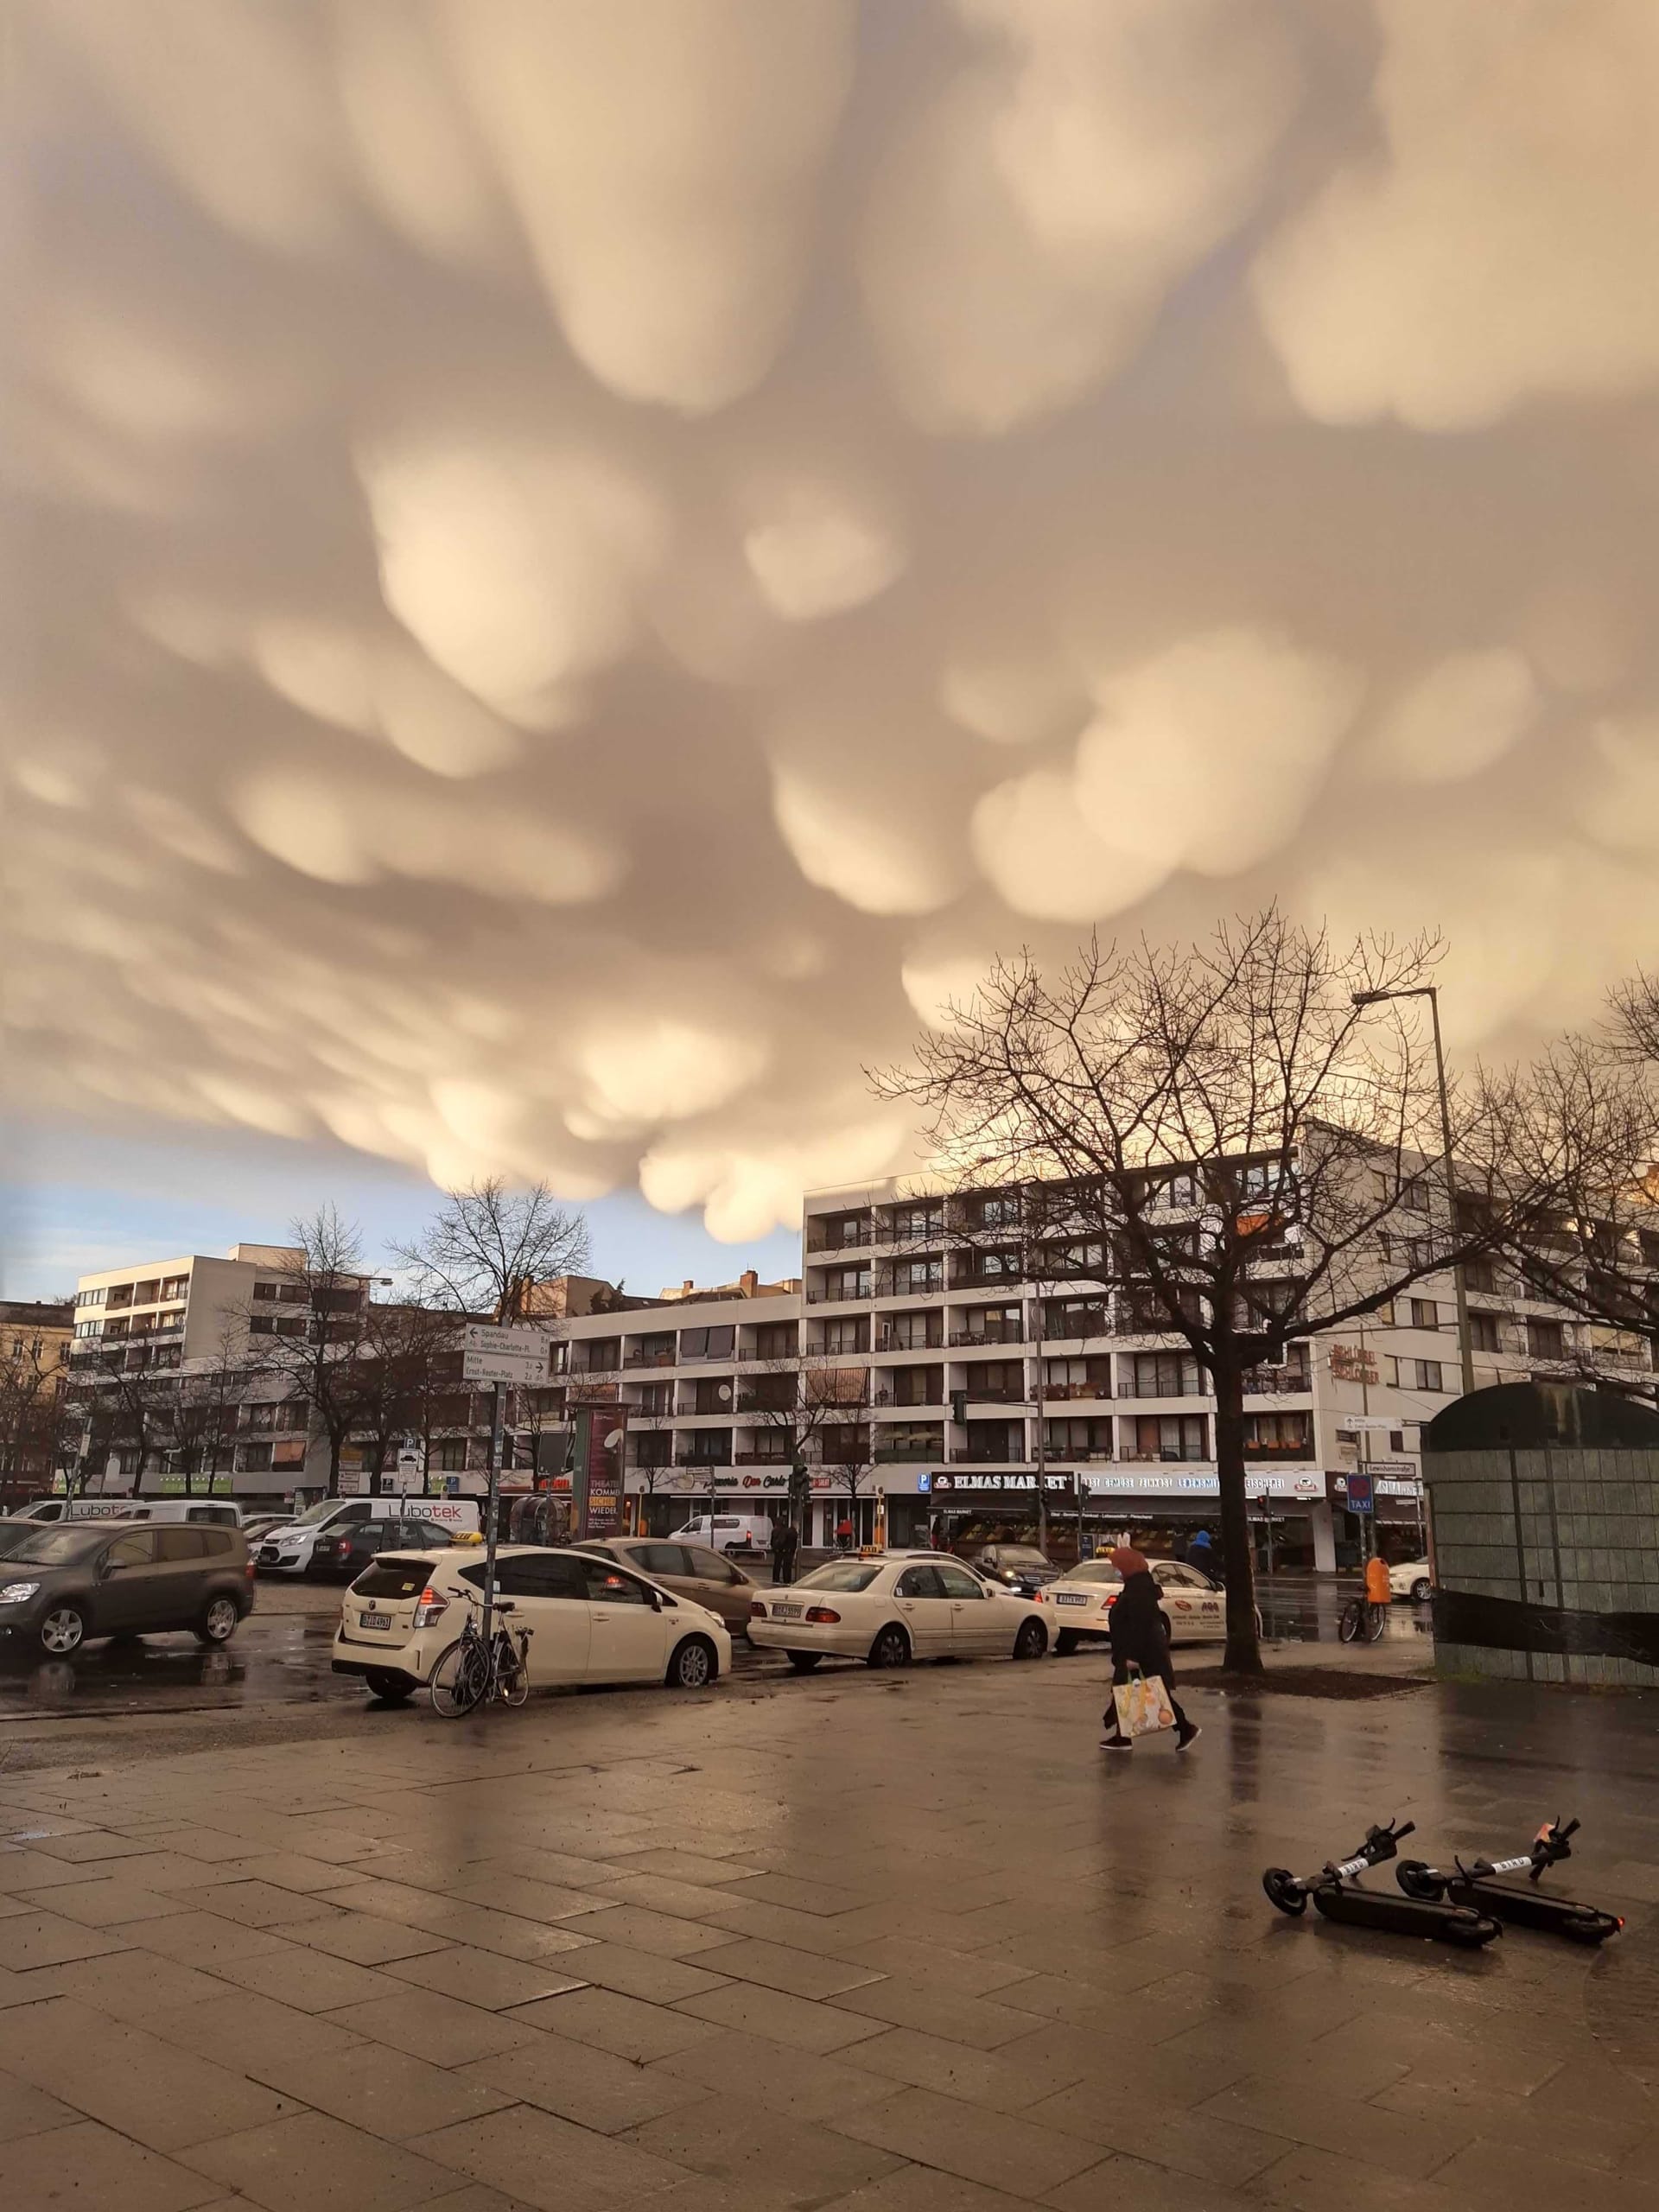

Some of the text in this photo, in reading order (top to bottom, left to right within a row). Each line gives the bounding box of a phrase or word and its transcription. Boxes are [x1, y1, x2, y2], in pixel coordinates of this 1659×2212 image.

[480, 1329, 509, 1340] Spandau
[467, 1356, 483, 1364] Mitte
[920, 1474, 927, 1484] P
[954, 1476, 1001, 1490] ELMAS
[1178, 1478, 1219, 1489] LEBENSMIT
[1245, 1478, 1285, 1488] EISCHEREI
[70, 1504, 129, 1516] Lubot
[1350, 1500, 1370, 1509] TAXI
[388, 1504, 462, 1519] Lubotek
[1343, 1860, 1363, 1873] BIRD
[1500, 1859, 1524, 1869] BIRD
